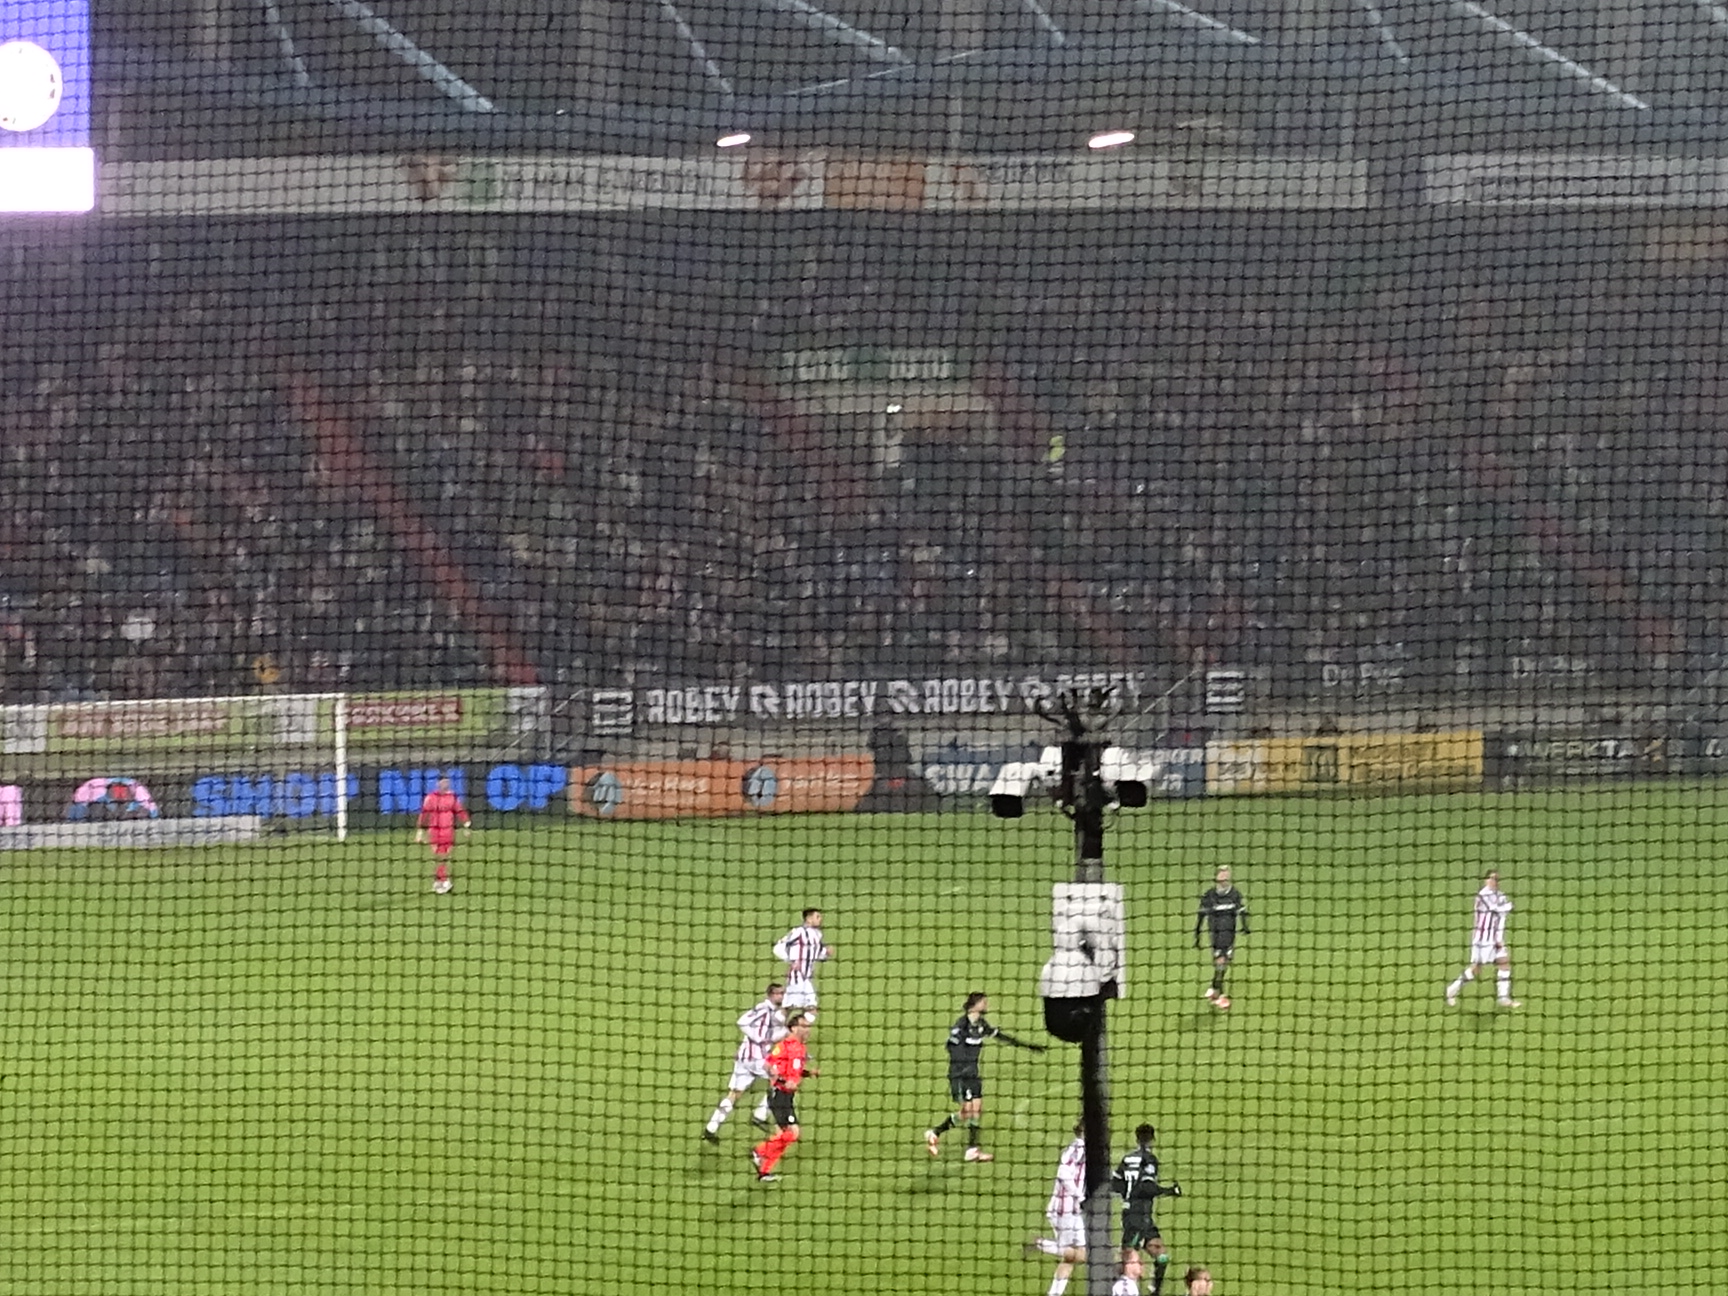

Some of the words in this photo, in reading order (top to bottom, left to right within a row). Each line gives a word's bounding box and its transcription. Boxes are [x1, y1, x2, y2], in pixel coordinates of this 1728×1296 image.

[647, 686, 741, 724] ROBEY
[786, 680, 877, 719] ROBEY
[923, 678, 1014, 713] ROBEY
[192, 771, 360, 819] SHOP
[485, 763, 567, 812] OP
